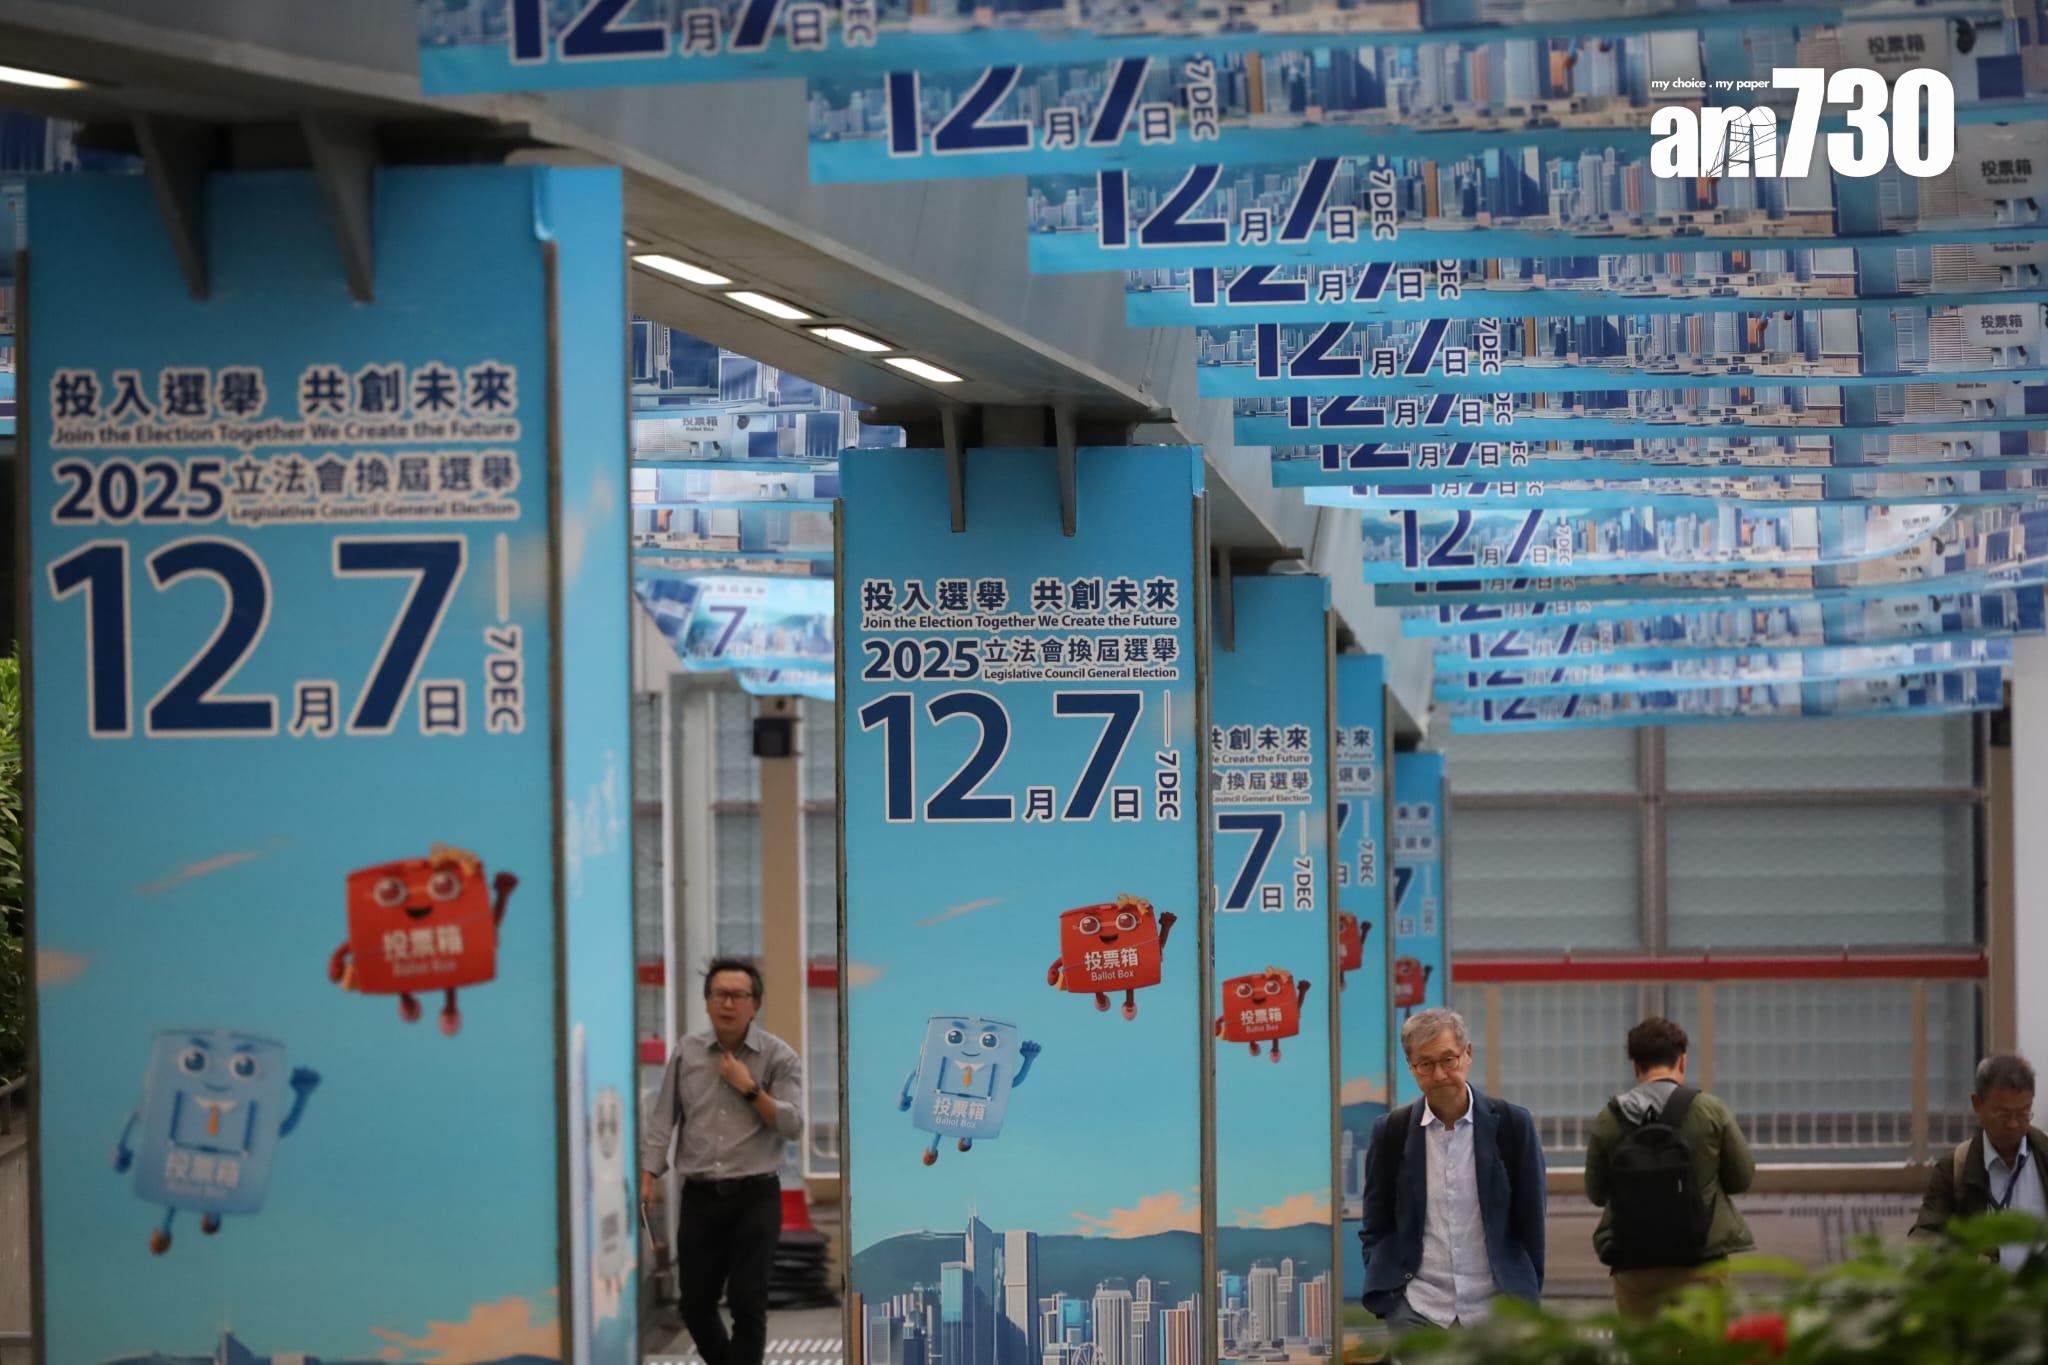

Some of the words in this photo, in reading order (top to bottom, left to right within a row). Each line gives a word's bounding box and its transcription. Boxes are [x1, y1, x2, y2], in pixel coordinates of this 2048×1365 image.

[1189, 83, 1217, 138] DEC
[1369, 170, 1392, 186] 7
[1981, 159, 2032, 177] 投票箱
[1373, 190, 1395, 239] DEC
[1981, 314, 2022, 329] 投票箱
[1483, 335, 1498, 373] DEC
[54, 372, 263, 417] 投入選舉
[303, 366, 513, 413] 共創未來
[55, 426, 94, 443] Join
[99, 425, 130, 441] the
[136, 425, 214, 442] Election
[218, 424, 304, 444] Together
[310, 424, 340, 438] We
[345, 422, 408, 438] Create
[413, 421, 446, 436] the
[450, 420, 515, 437] Future
[56, 463, 223, 519] 2025
[864, 581, 1006, 611] 投入選舉
[1034, 578, 1176, 610] 共創未來
[863, 616, 891, 628] Join
[894, 616, 916, 628] the
[919, 615, 973, 628] Election
[975, 615, 1036, 630] Together
[1038, 615, 1059, 627] We
[1062, 614, 1105, 627] Create
[1108, 614, 1130, 626] the
[1133, 613, 1177, 626] Future
[488, 630, 519, 651] 7
[864, 639, 980, 679] 2025
[984, 668, 1043, 680] Legislative
[1045, 667, 1085, 678] Council
[1087, 667, 1130, 678] General
[1133, 667, 1177, 678] Election
[488, 660, 520, 730] DEC
[1158, 752, 1177, 767] 7
[1222, 754, 1256, 764] Create
[1257, 753, 1275, 763] the
[1276, 753, 1310, 763] Future
[1158, 773, 1178, 819] DEC
[1213, 795, 1240, 803] ouncil
[1295, 859, 1310, 868] 7
[1360, 854, 1373, 884] DEC
[1295, 873, 1311, 908] DEC
[1084, 947, 1139, 971] 投票箱
[1091, 970, 1116, 981] Ballot
[1117, 970, 1135, 979] Box
[1240, 1007, 1282, 1026] 投票箱
[932, 1097, 986, 1121] 投票箱
[935, 1116, 960, 1128] Ballot
[960, 1118, 976, 1129] Box
